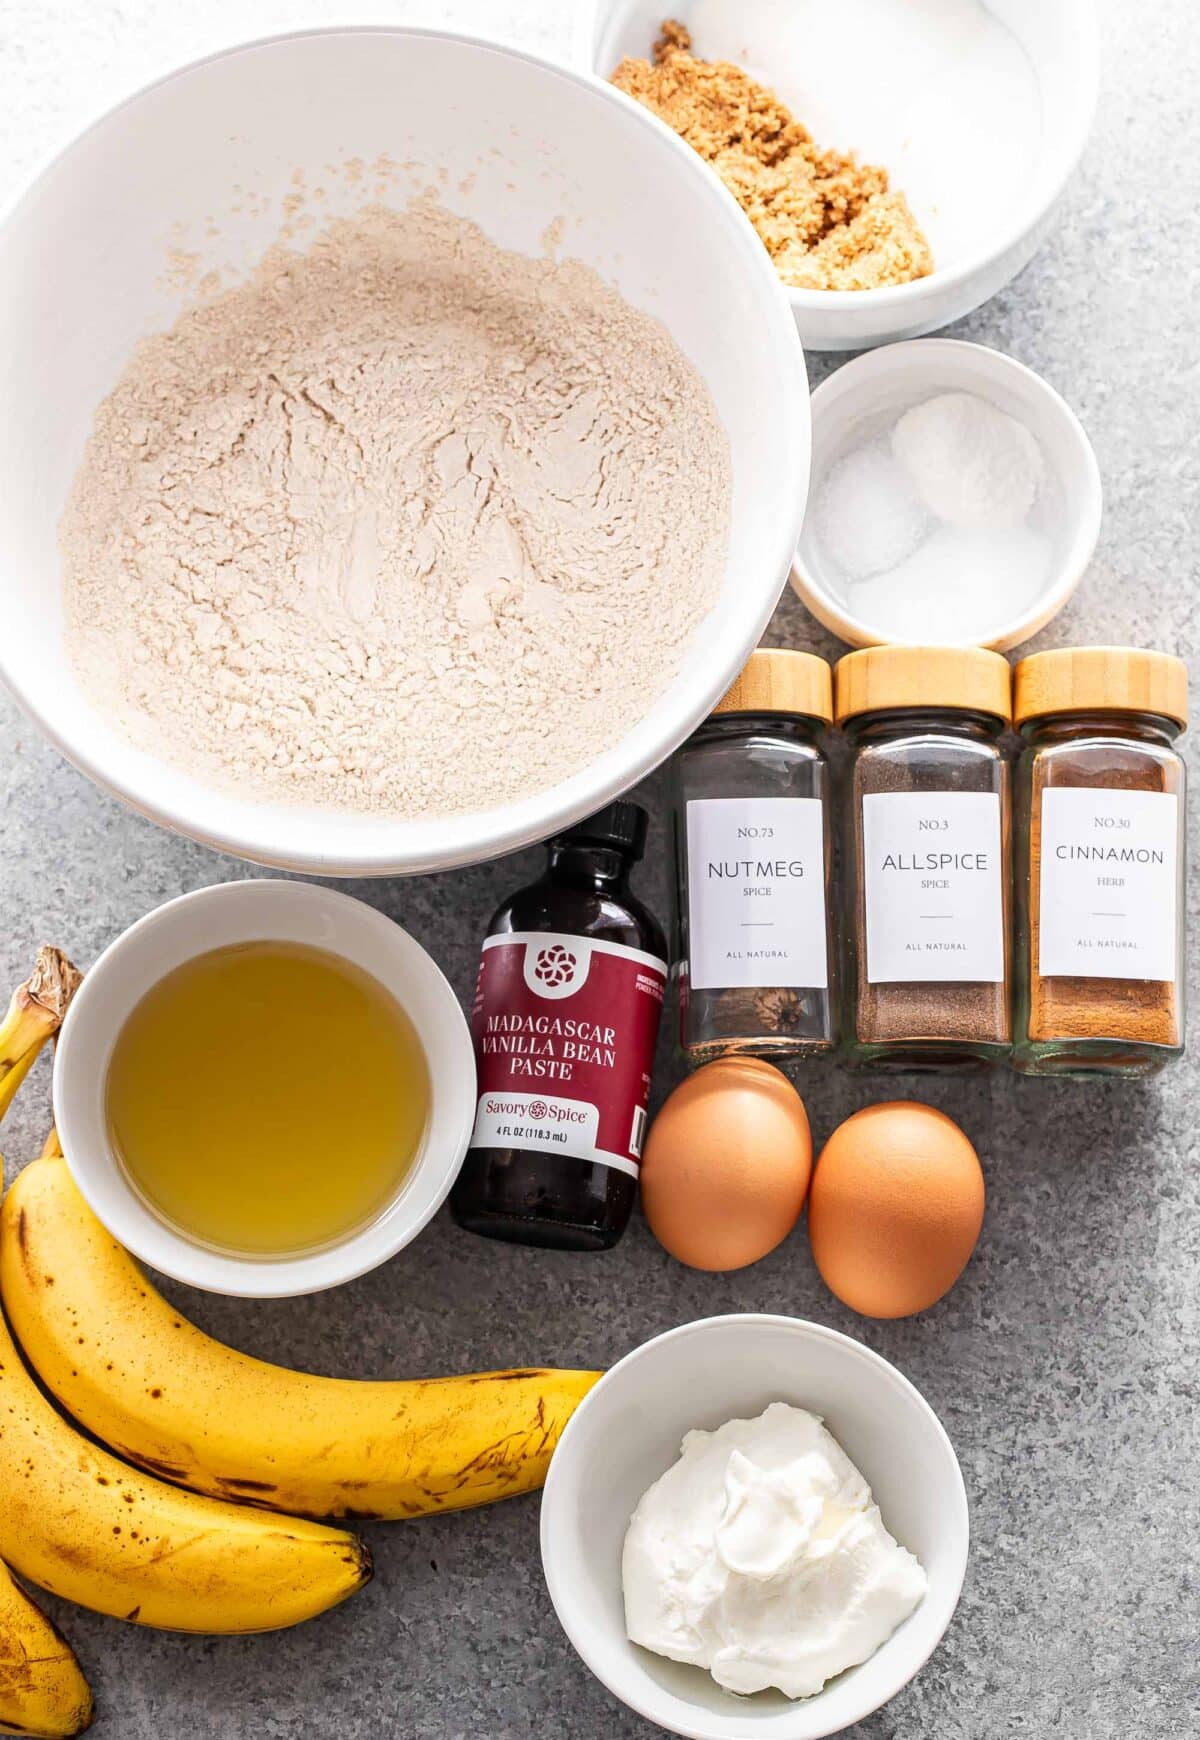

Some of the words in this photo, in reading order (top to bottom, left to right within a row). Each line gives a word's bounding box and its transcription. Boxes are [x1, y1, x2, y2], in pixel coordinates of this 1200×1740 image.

[918, 819, 949, 830] NO.3
[1094, 817, 1131, 829] NO.30
[737, 828, 774, 839] NO.73
[1056, 846, 1164, 864] CINNAMON
[882, 854, 988, 870] ALLSPICE
[708, 861, 804, 878] NUTMEG
[921, 880, 949, 889] SPICE
[1097, 877, 1125, 887] HERB
[743, 888, 771, 897] SPICE
[906, 943, 922, 951] ALL
[925, 943, 967, 951] NATURAL
[1077, 940, 1094, 948] ALL
[1097, 940, 1138, 950] NATURAL
[726, 951, 743, 959] ALL
[747, 951, 788, 959] NATURAL
[486, 1015, 616, 1046] MADAGASCAR
[482, 1036, 554, 1056] VANILLA
[563, 1042, 616, 1068] BEAN
[510, 1058, 573, 1080] PASTE
[486, 1100, 528, 1117] Savory
[548, 1105, 588, 1124] Spice
[496, 1127, 501, 1135] 4
[503, 1127, 512, 1136] FL
[514, 1127, 524, 1137] OZ
[552, 1132, 568, 1143] mL)
